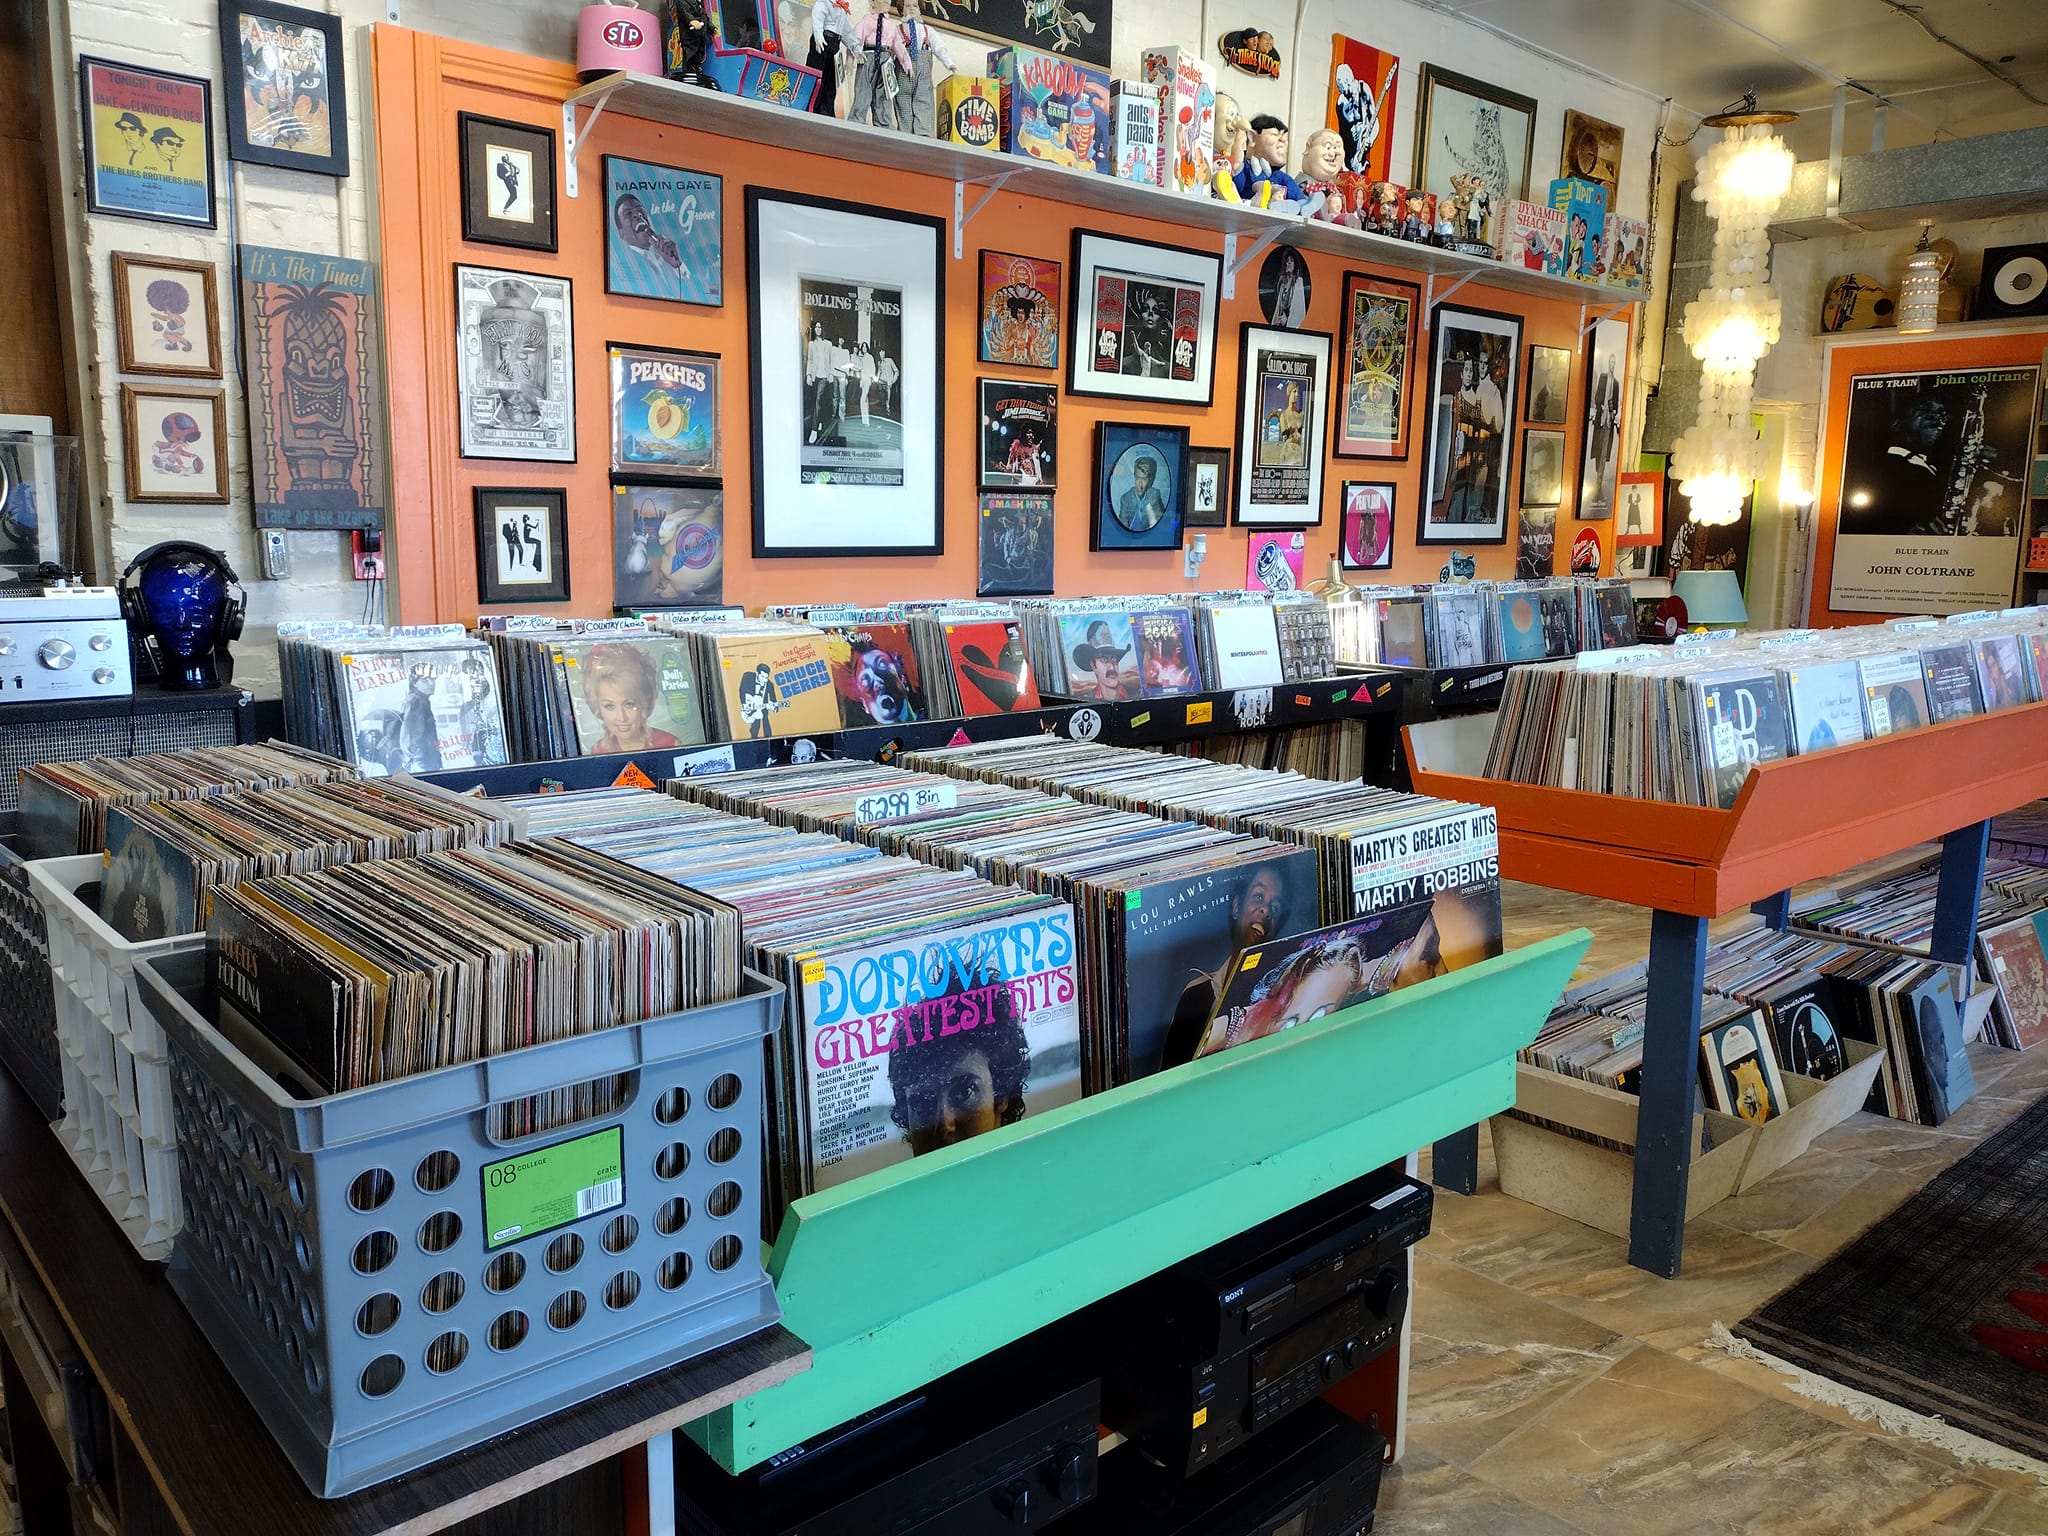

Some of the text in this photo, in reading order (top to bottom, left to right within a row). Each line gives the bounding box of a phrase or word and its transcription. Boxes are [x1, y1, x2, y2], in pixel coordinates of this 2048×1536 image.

[249, 21, 305, 51] Archie
[607, 21, 641, 44] STP
[108, 72, 150, 89] TONIGHT
[156, 82, 182, 96] ONLY
[1023, 57, 1087, 101] KABOOM
[130, 101, 169, 118] ELWOOD
[172, 109, 203, 124] BLUES
[958, 98, 994, 121] TIME
[1127, 104, 1149, 123] ants
[960, 122, 995, 142] BOMB
[1127, 123, 1154, 145] pants
[101, 164, 204, 188] THE BLUES BROTHERS BAND
[615, 179, 712, 192] MARVIN GAYE
[650, 194, 716, 234] in the Groove
[1516, 214, 1548, 231] SHACK
[1518, 202, 1566, 224] DYNAMITE
[251, 251, 367, 289] It's Tiki Time!
[804, 292, 900, 317] ROLLING STONES
[630, 362, 706, 392] PEACHES
[1857, 371, 2031, 390] BLUE TRAIN john coltrane
[995, 399, 1009, 411] GET
[1010, 398, 1027, 409] THAT
[988, 499, 1048, 509] SMASH HITS
[1264, 565, 1283, 587] LOVE
[1867, 565, 1975, 577] JOHN COLTRANE
[586, 619, 645, 631] COUNTRY Classics
[811, 610, 856, 623] AEROSMITH
[384, 626, 442, 640] Modern
[350, 655, 401, 676] STEVE
[663, 668, 684, 684] Dolly
[774, 660, 828, 686] CHUCK
[356, 668, 408, 692] EARLE
[662, 679, 690, 691] Parton
[780, 672, 832, 699] BERRY
[1239, 715, 1266, 729] ROCK
[624, 770, 639, 778] NEW
[858, 790, 940, 823] $2.99 Bin
[1353, 813, 1496, 867] MARTY'S GREATEST HITS
[1355, 857, 1499, 914] MARTY ROBBINS
[1461, 883, 1486, 894] COLUMBIA
[1131, 876, 1213, 930] LOU RAWLS
[1143, 894, 1230, 935] ALL THINGS IN TIME
[814, 913, 1073, 1026] DONOVAN'S
[218, 955, 261, 1014] HOT TUNA
[814, 966, 1075, 1069] GREATEST HITS
[817, 1060, 867, 1080] MELLOW YELLOW
[817, 1065, 880, 1087] SUNSHINE SUPERMAN
[817, 1075, 874, 1096] HURDY GURDY MAN
[818, 1092, 841, 1104] EPISTLE
[854, 1083, 870, 1094] DIPPY
[818, 1092, 869, 1112] WEAR YOUR LOVE
[818, 1103, 856, 1119] LIKE HEAVEN
[819, 1106, 871, 1127] JENNIFER JUNIPER
[820, 1122, 846, 1135] COLOURS
[820, 1122, 870, 1143] CATCH THE WIND
[820, 1141, 838, 1151] THERE
[856, 1125, 885, 1140] MOUNTAIN
[820, 1147, 843, 1160] SEASON
[856, 1140, 866, 1148] THE
[869, 1133, 887, 1143] WITCH
[490, 1157, 547, 1188] 08 COLLEGE
[597, 1164, 617, 1176] crate
[821, 1156, 843, 1168] LALENA
[1225, 1288, 1244, 1302] SONY
[1201, 1364, 1213, 1376] JVC
